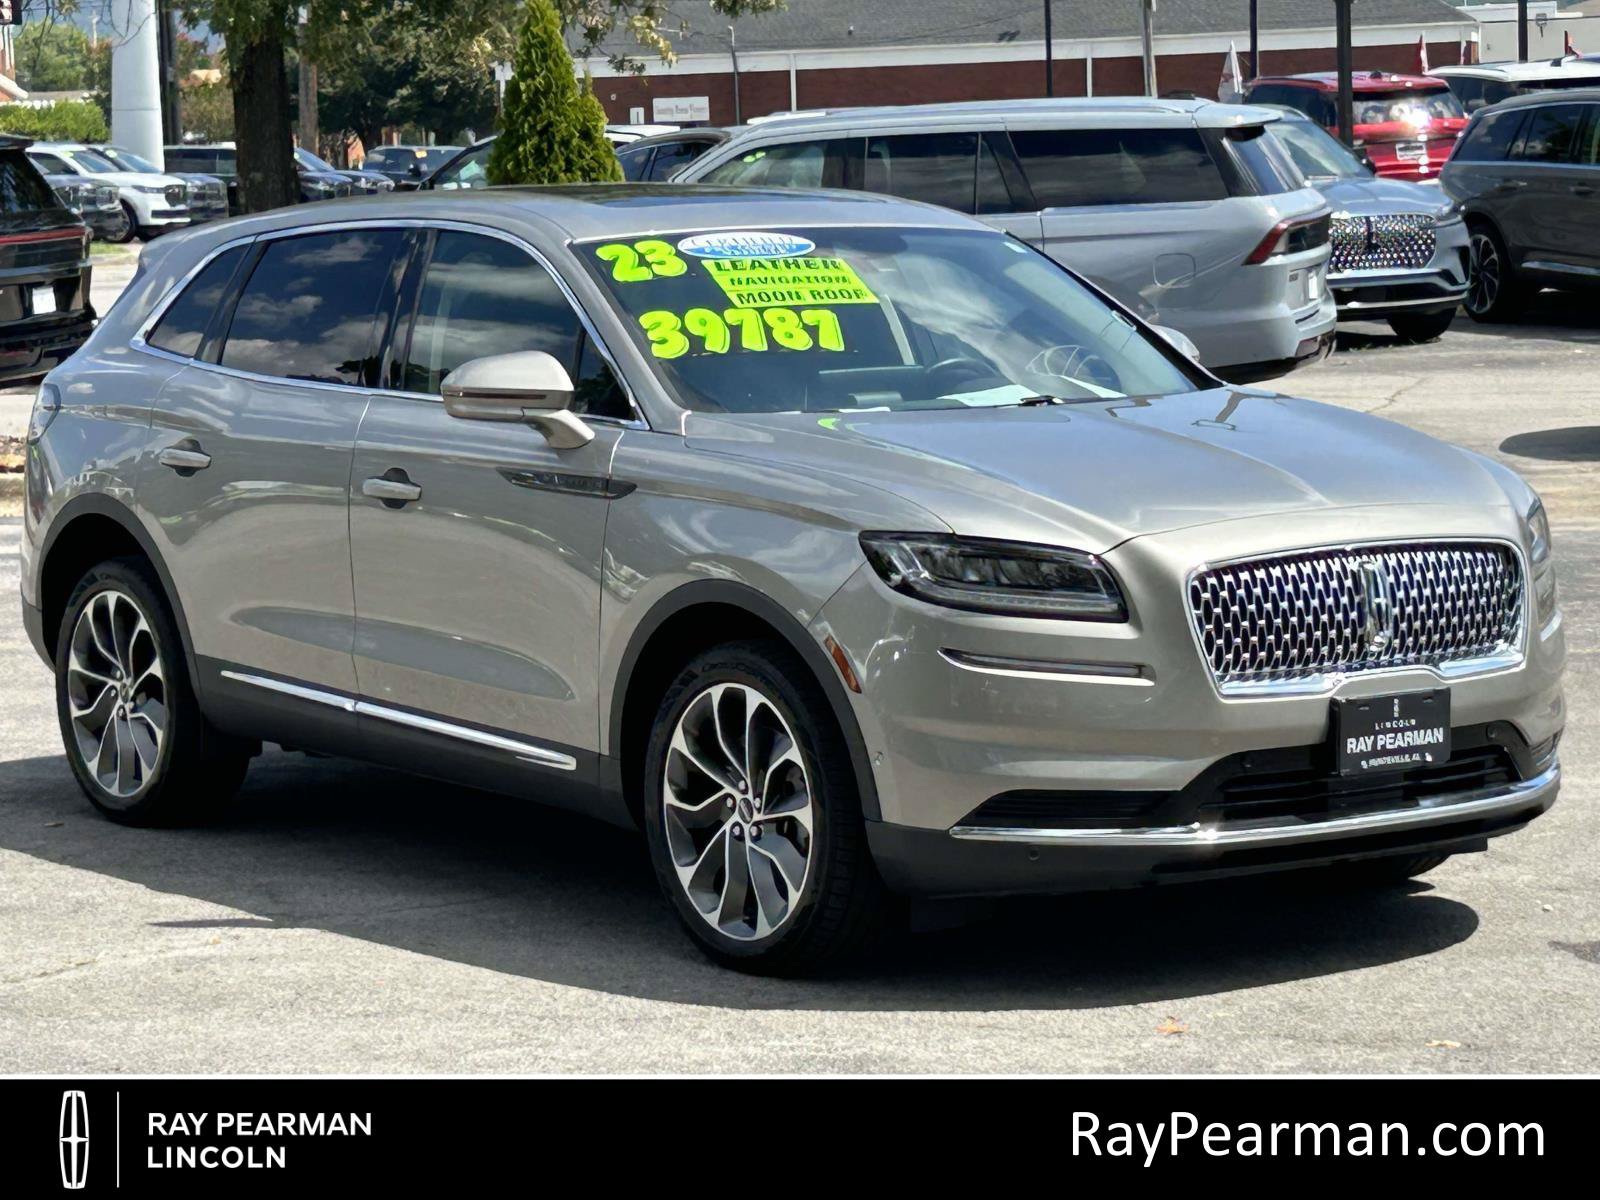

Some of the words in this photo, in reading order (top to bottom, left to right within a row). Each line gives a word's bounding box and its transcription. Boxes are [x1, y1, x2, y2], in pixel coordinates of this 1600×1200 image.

[596, 240, 688, 282] 23
[714, 258, 842, 272] LEATHER
[730, 275, 850, 286] NAVIGATION
[736, 290, 803, 305] MOON
[809, 288, 866, 301] ROOF
[639, 308, 845, 359] 39787
[1347, 736, 1375, 754] RAY
[1377, 727, 1444, 750] PEARMAN
